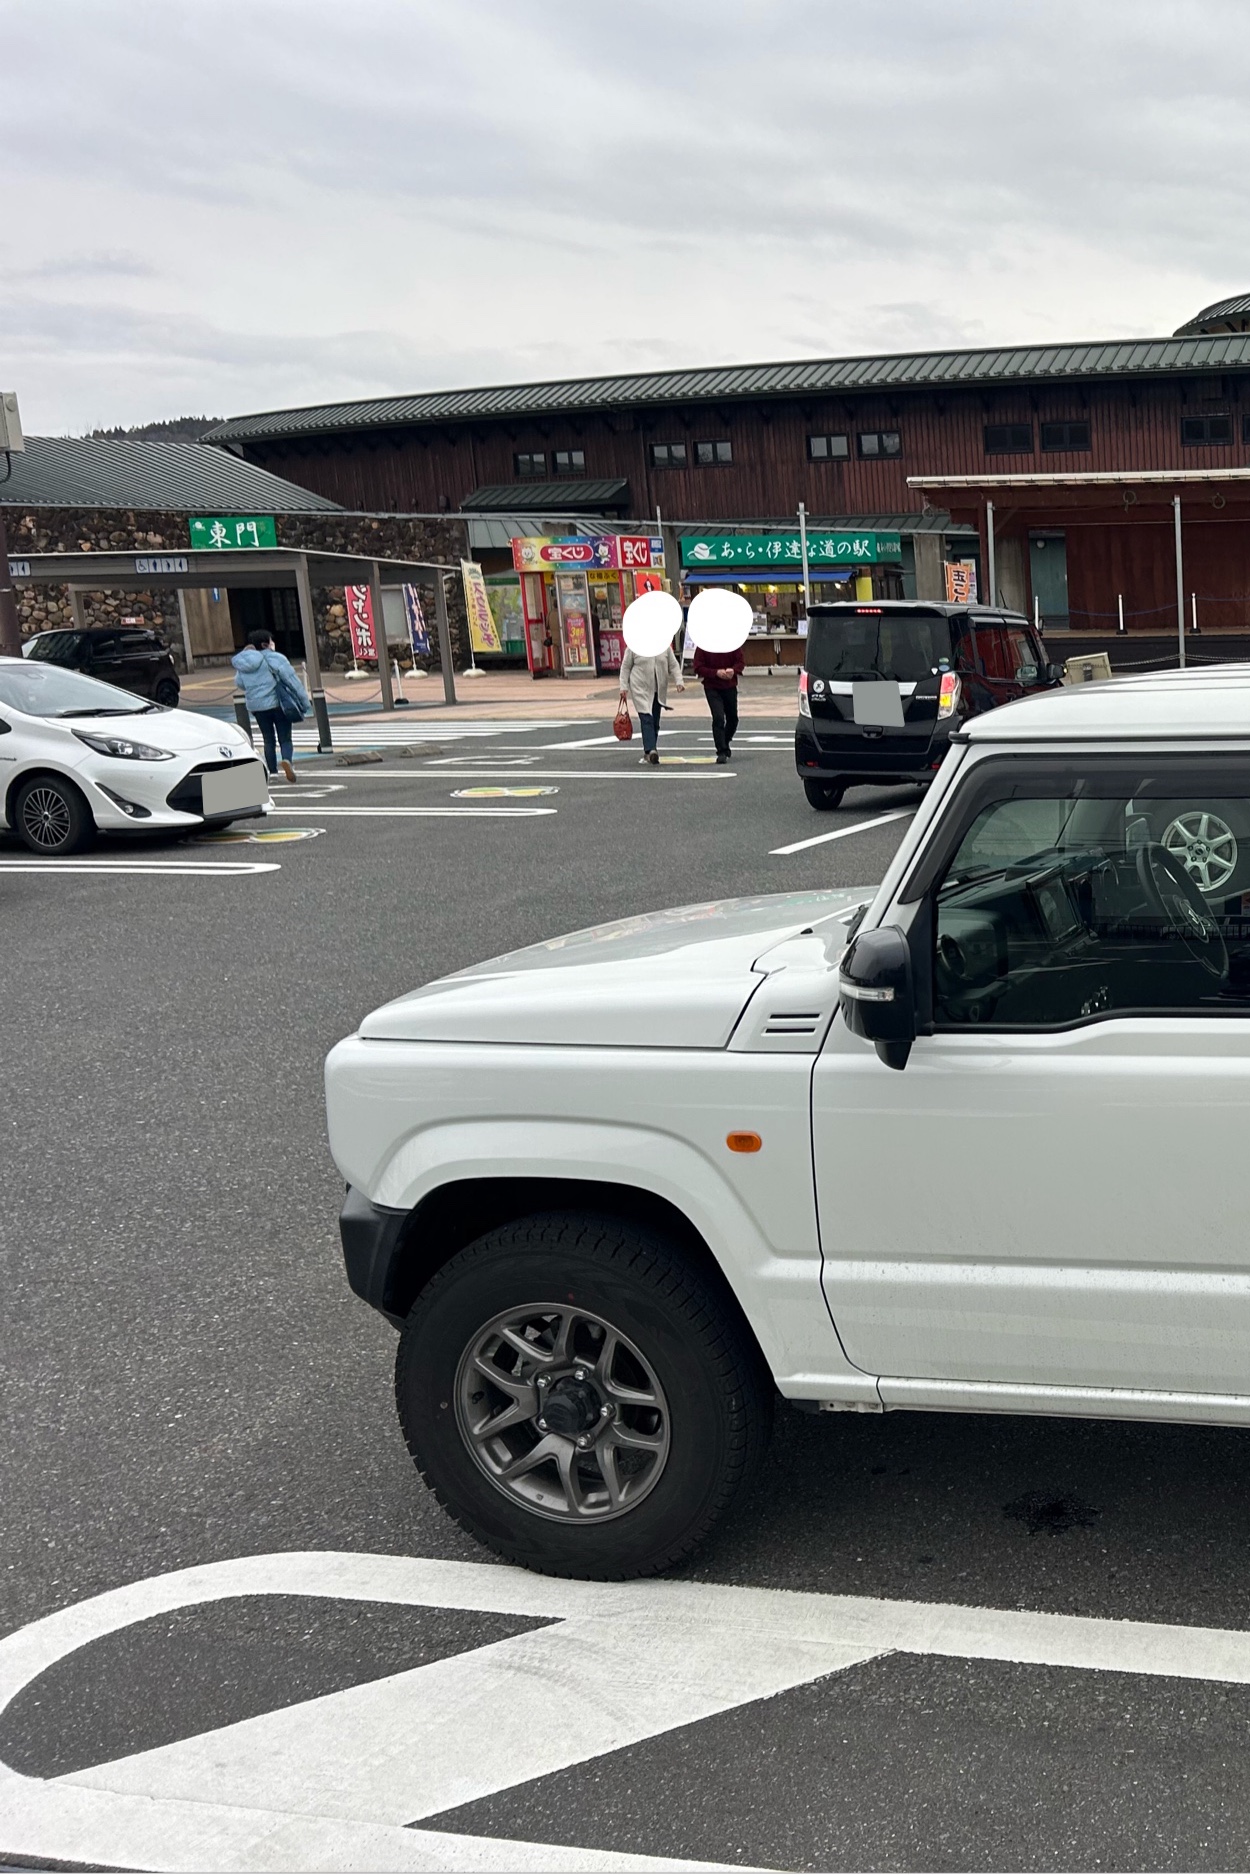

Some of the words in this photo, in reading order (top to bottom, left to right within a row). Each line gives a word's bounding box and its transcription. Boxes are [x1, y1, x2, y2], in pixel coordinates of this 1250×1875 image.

[208, 520, 260, 548] 東門
[547, 546, 585, 560] 宝くじ
[623, 540, 648, 564] 宝くじ
